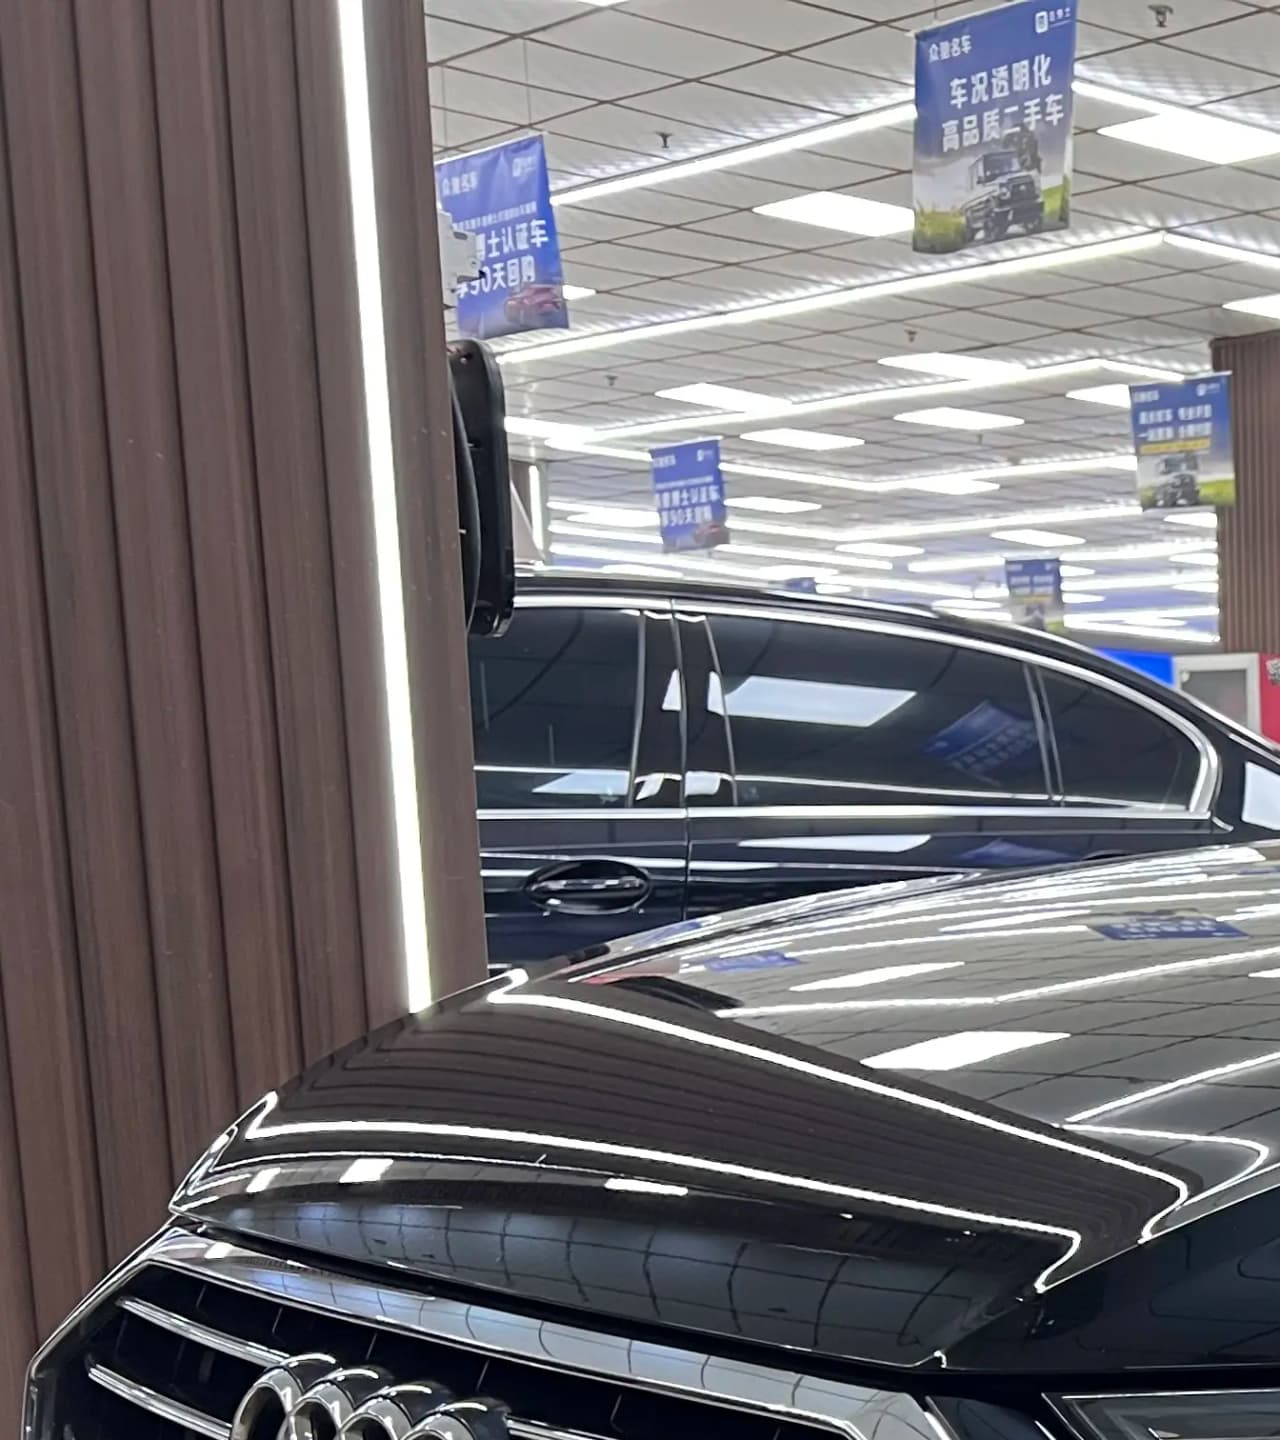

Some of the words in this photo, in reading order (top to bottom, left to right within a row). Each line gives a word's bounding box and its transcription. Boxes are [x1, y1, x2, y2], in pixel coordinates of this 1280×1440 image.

[949, 53, 1052, 109] 车况透明化
[941, 93, 1065, 152] 高品质二手车
